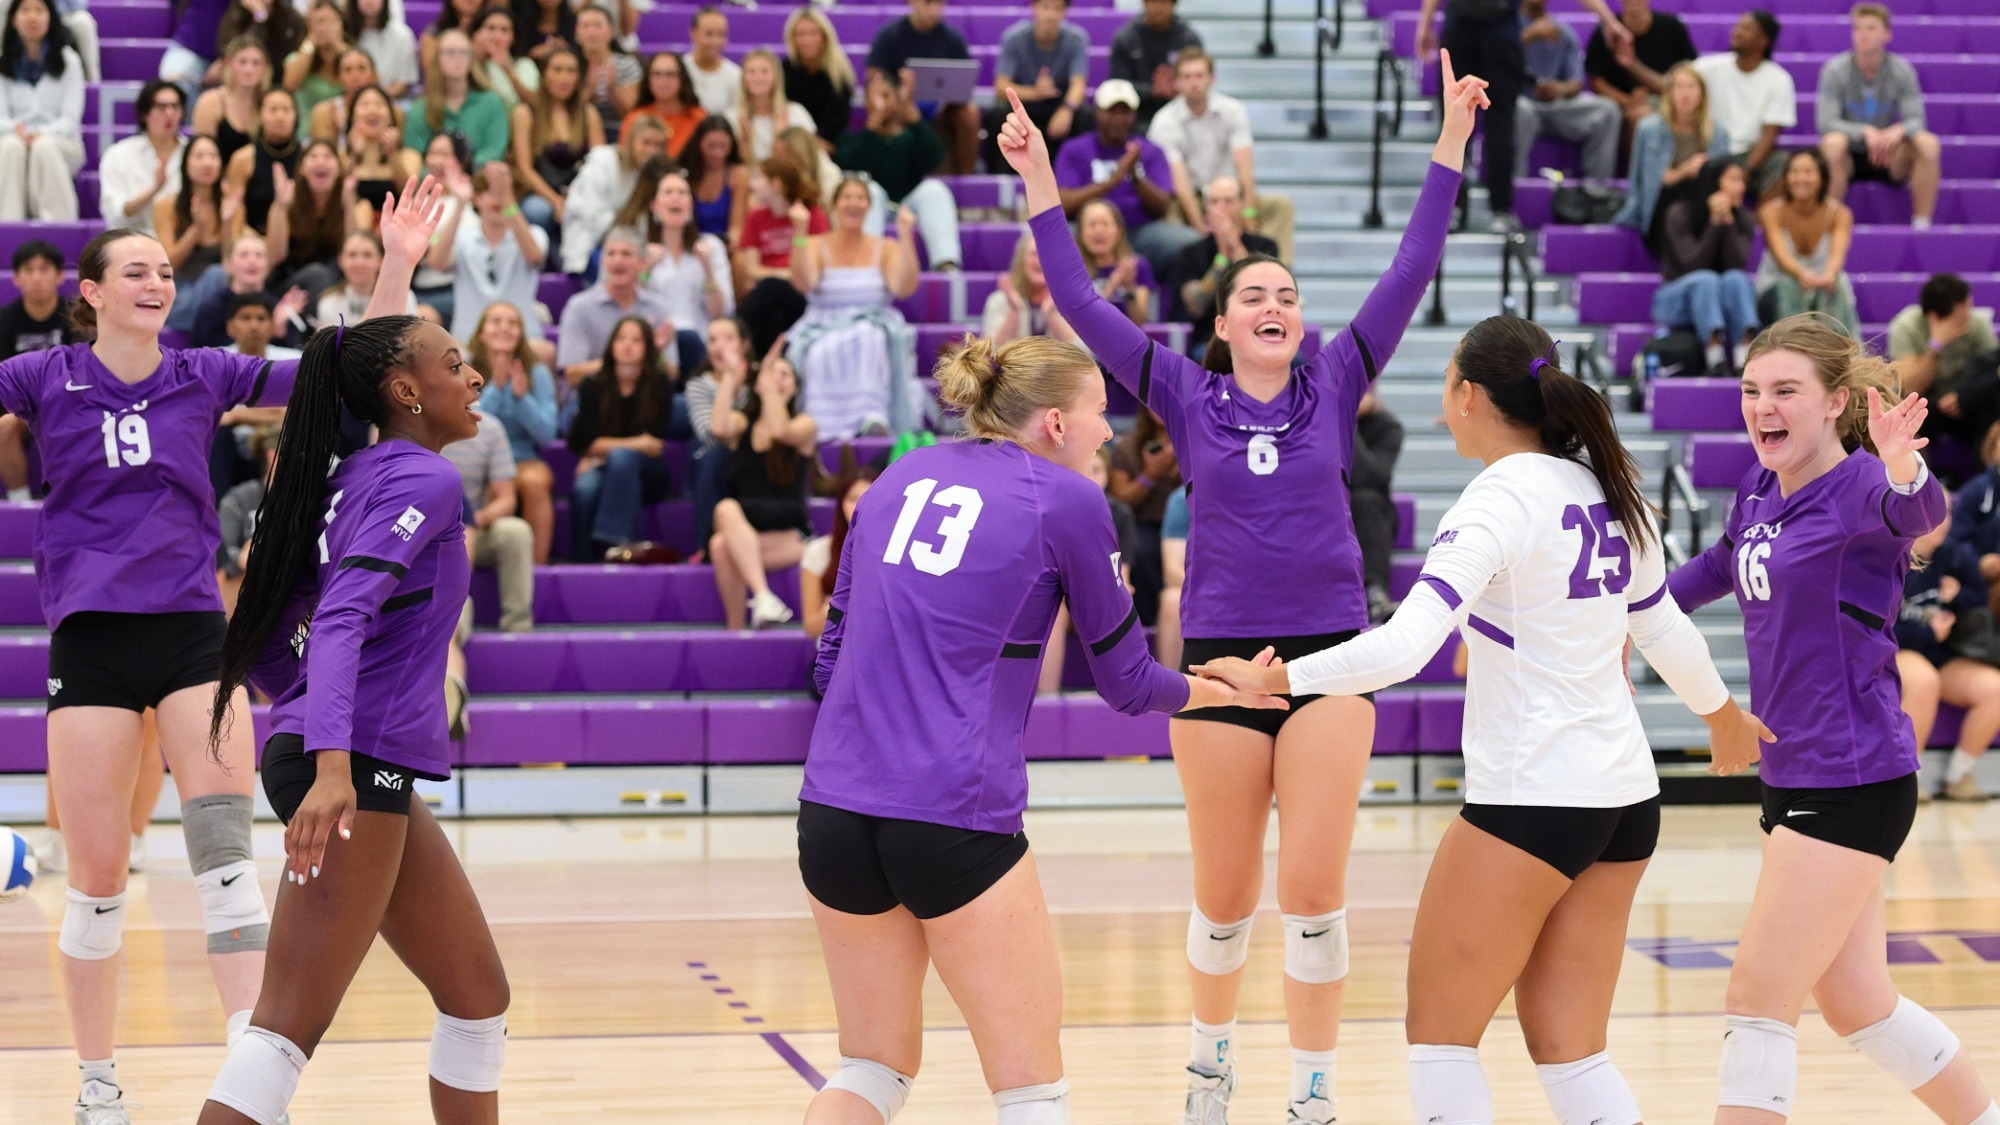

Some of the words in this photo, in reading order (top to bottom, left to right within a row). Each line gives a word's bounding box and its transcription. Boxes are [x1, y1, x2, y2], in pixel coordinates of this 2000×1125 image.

[101, 413, 152, 468] 19
[1247, 433, 1279, 475] 6
[390, 524, 412, 542] NYU
[883, 478, 984, 577] 13
[1561, 502, 1632, 599] 25
[1738, 541, 1772, 601] 16
